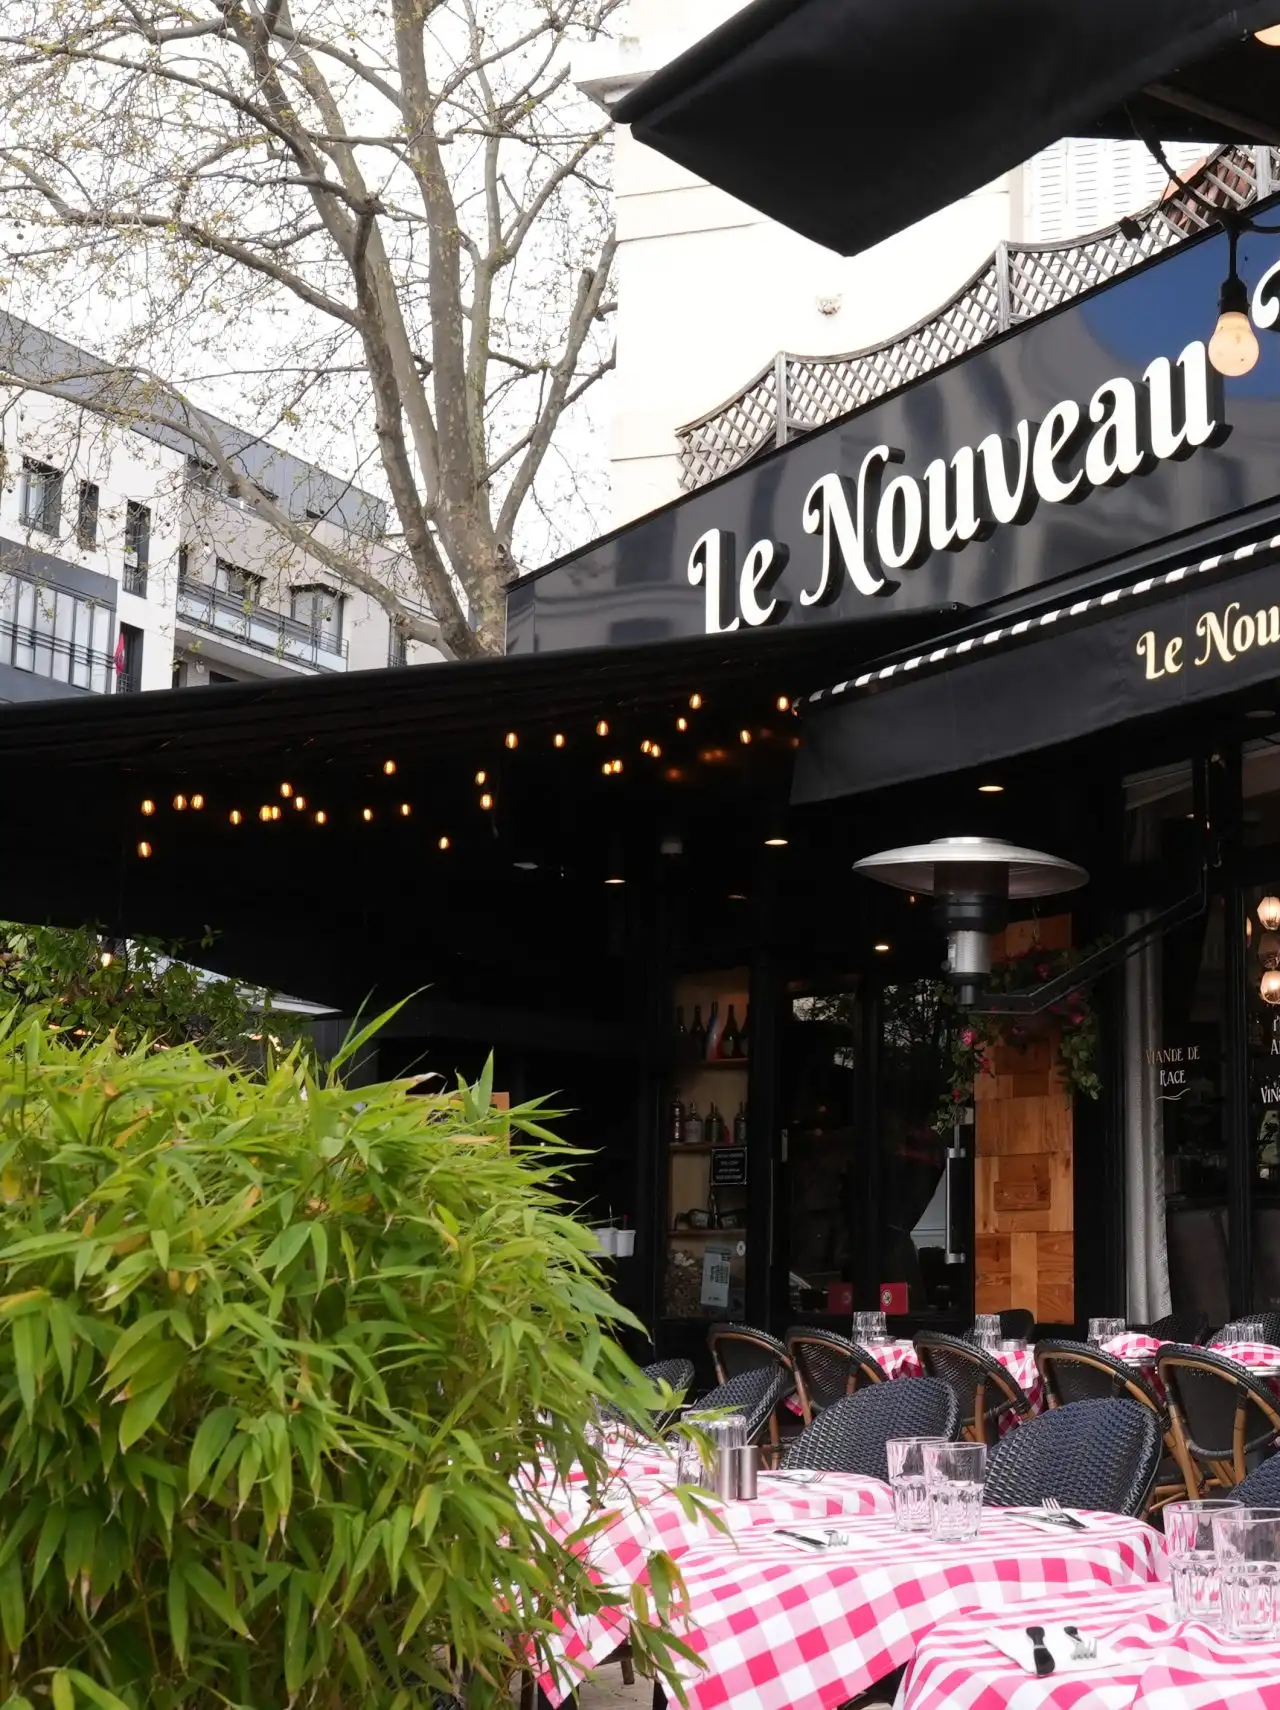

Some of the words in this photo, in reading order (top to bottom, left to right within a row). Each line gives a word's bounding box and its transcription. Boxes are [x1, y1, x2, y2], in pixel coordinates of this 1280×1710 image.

[687, 527, 780, 635] Le
[799, 340, 1220, 607] Nouveau
[1135, 630, 1184, 680] Le
[1187, 1045, 1201, 1061] DE
[1159, 1069, 1187, 1087] RACE
